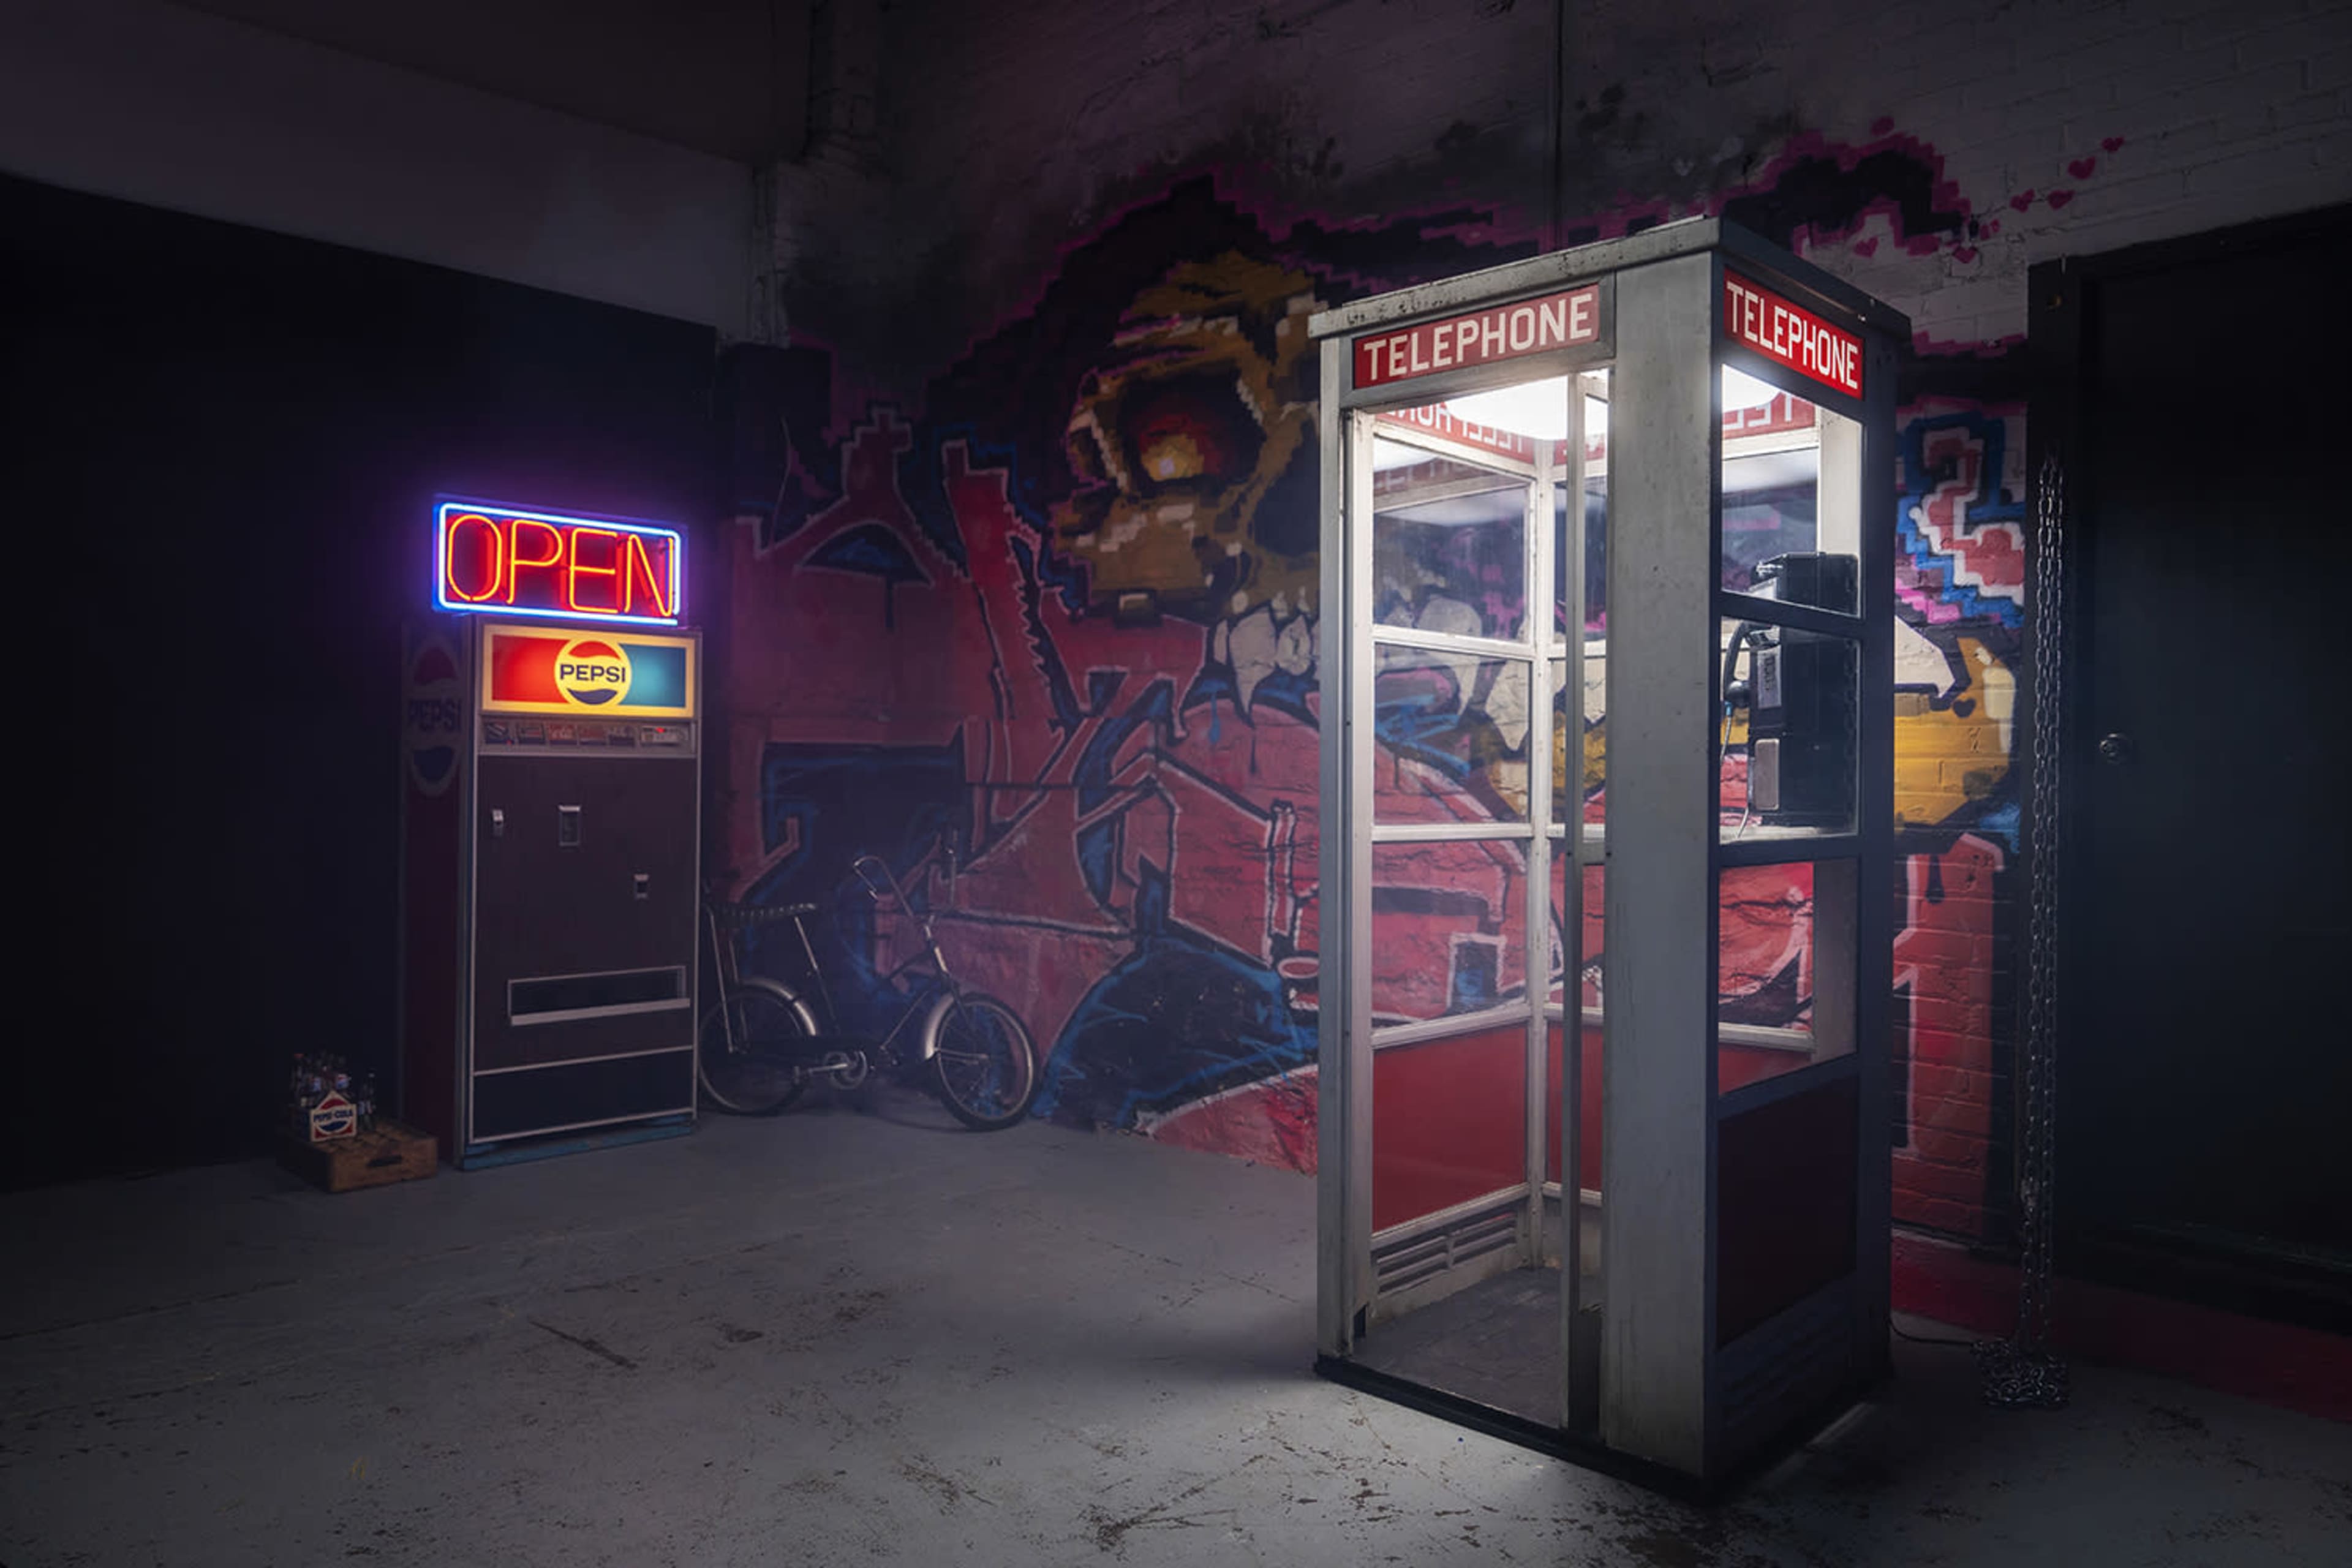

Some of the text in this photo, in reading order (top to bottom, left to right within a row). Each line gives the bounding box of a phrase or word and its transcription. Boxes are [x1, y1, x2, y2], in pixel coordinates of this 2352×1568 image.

[1363, 293, 1593, 381] TELEPHONE
[1726, 281, 1858, 390] TELEPHONE
[447, 514, 674, 617] OPEN
[560, 663, 626, 684] PEPSI
